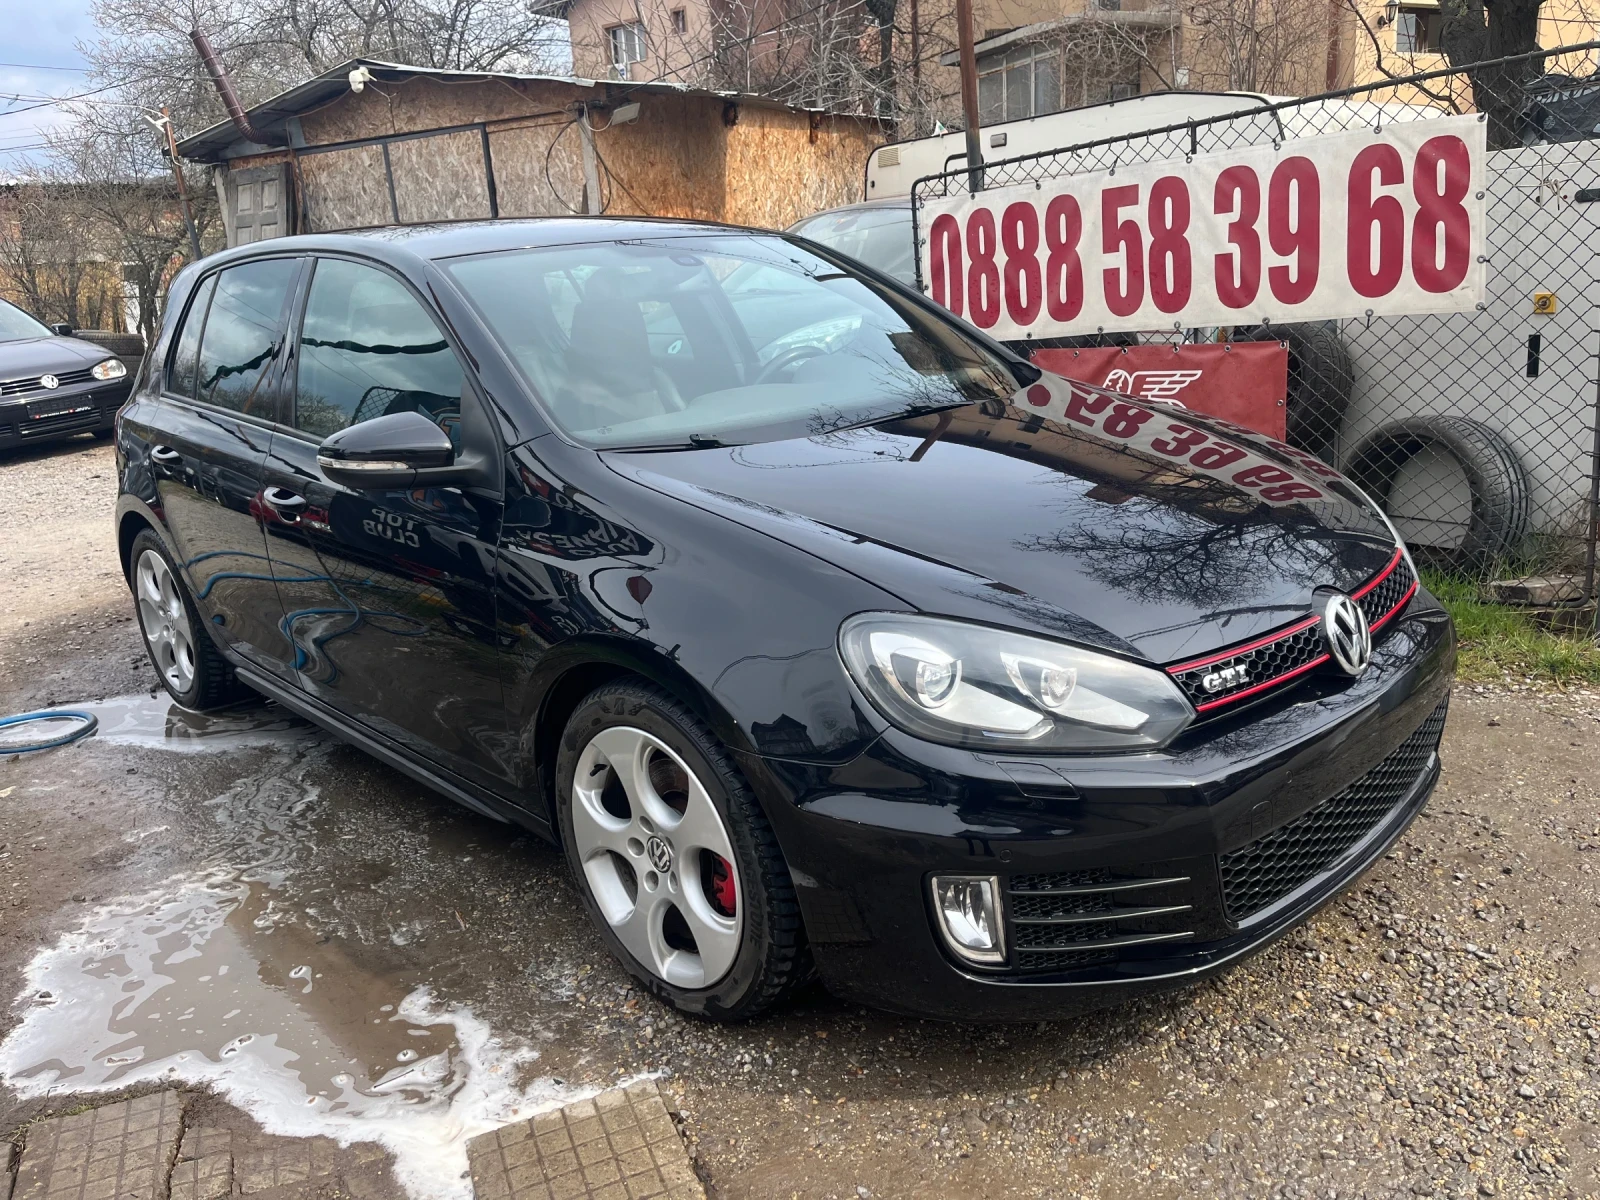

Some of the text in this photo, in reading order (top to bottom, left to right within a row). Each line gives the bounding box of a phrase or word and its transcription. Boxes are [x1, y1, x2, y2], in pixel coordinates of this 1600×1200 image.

[930, 135, 1470, 329] 0888 58 39 68
[1325, 595, 1372, 676] VW
[1202, 664, 1250, 693] GTI
[647, 836, 671, 873] VW
